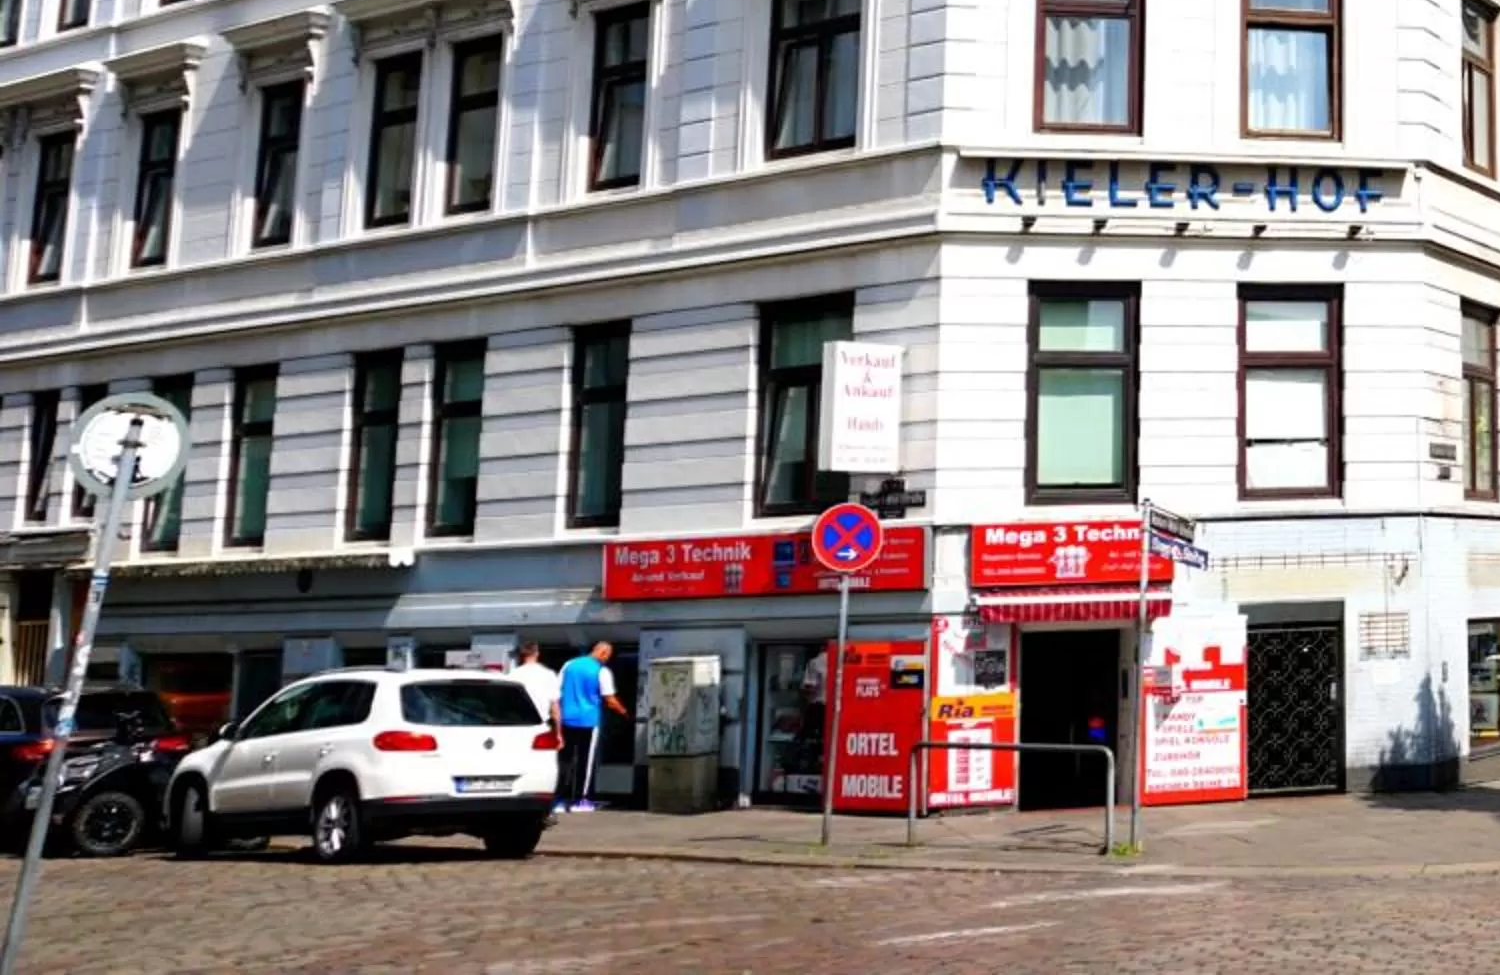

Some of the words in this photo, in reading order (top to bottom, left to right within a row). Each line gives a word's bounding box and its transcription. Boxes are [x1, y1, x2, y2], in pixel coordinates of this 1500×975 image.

[981, 157, 1384, 213] KIELER-HOF
[840, 351, 895, 369] Verkauf
[844, 384, 894, 398] Ankauf
[985, 527, 1046, 547] Mega
[1053, 526, 1067, 542] 3
[1074, 524, 1143, 543] Techn
[614, 543, 659, 569] Mega
[665, 543, 676, 563] 3
[681, 541, 751, 563] Technik
[938, 700, 974, 718] Ria
[846, 732, 899, 757] ORTEL
[841, 775, 903, 799] MOBILE
